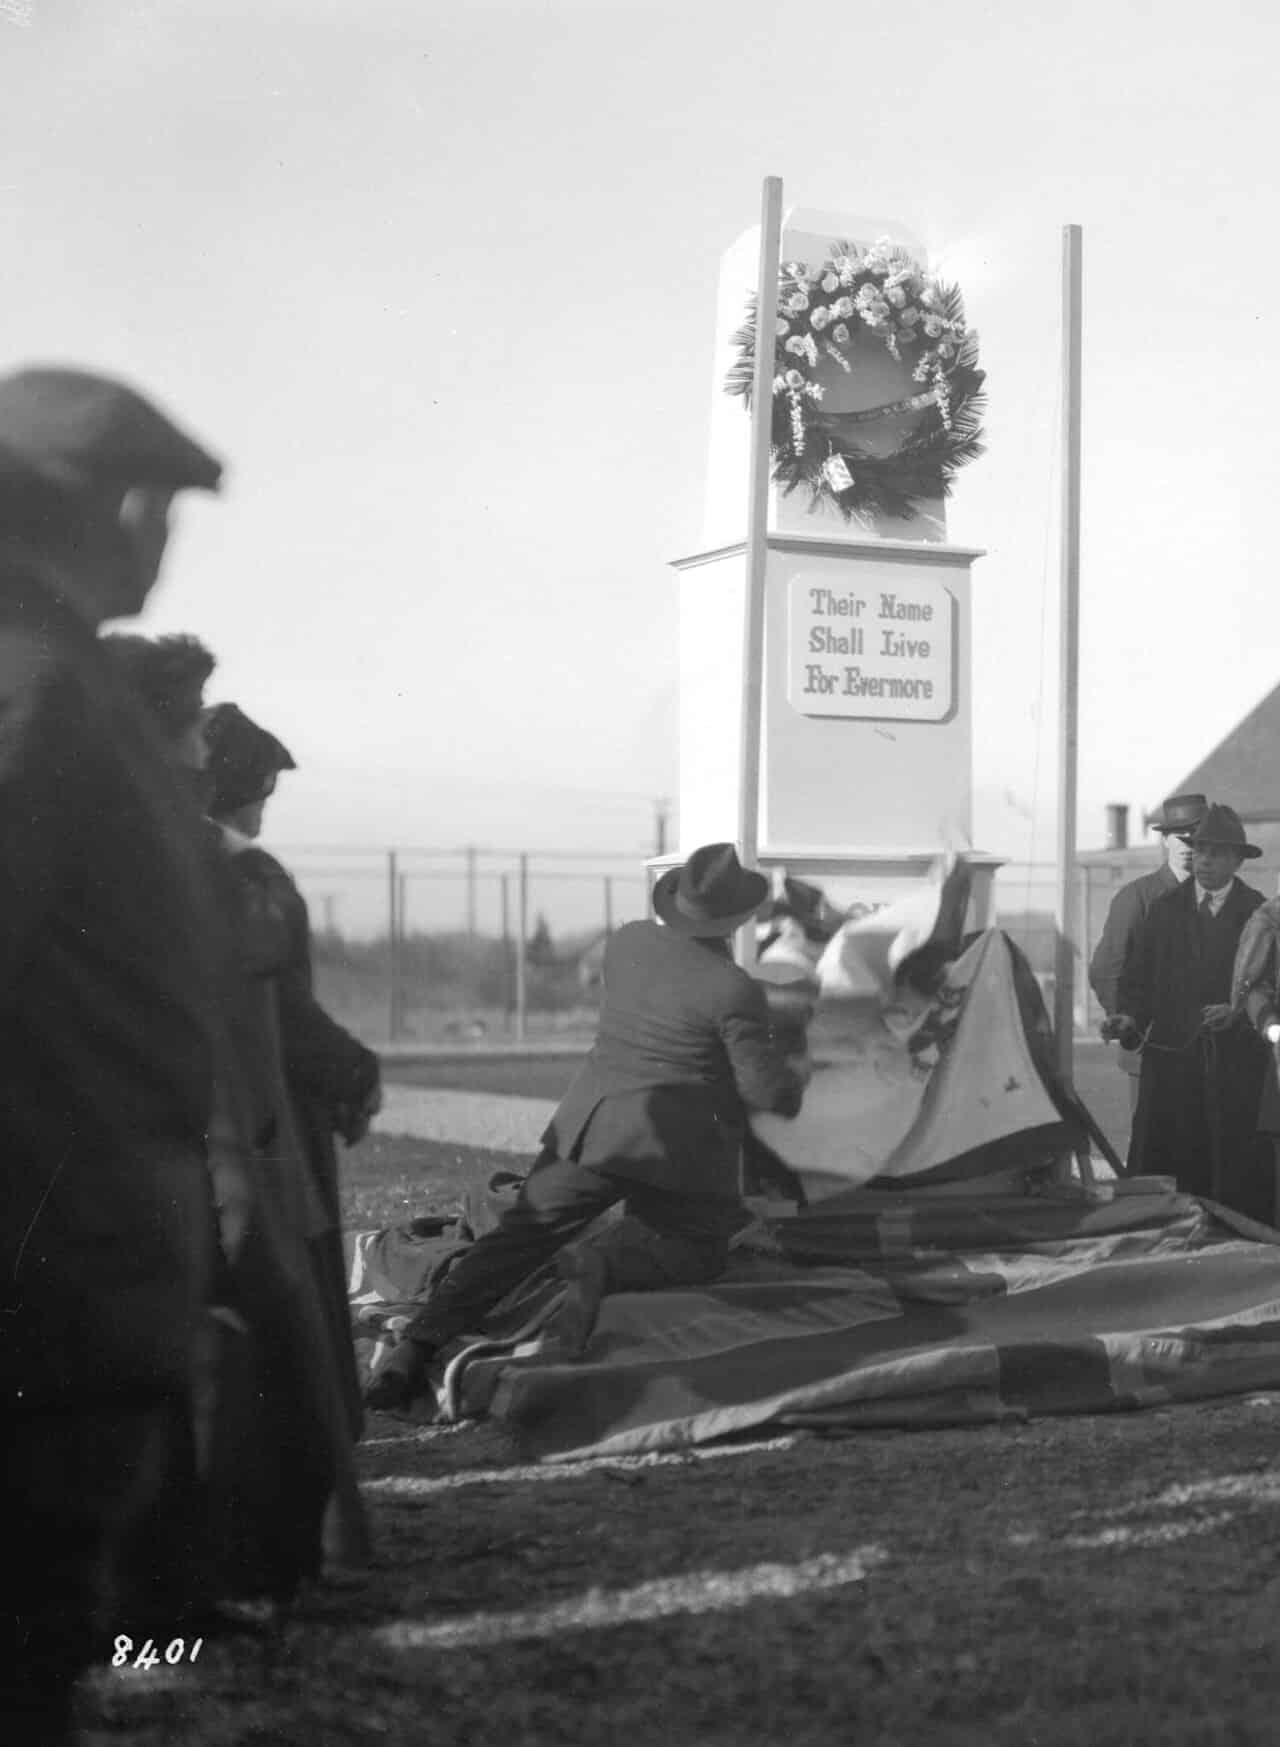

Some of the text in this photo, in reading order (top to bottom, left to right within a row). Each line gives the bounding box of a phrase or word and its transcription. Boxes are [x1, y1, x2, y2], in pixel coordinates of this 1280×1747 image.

[809, 588, 934, 621] Their Name
[808, 626, 931, 658] Shall Live
[804, 664, 933, 699] For Evermore
